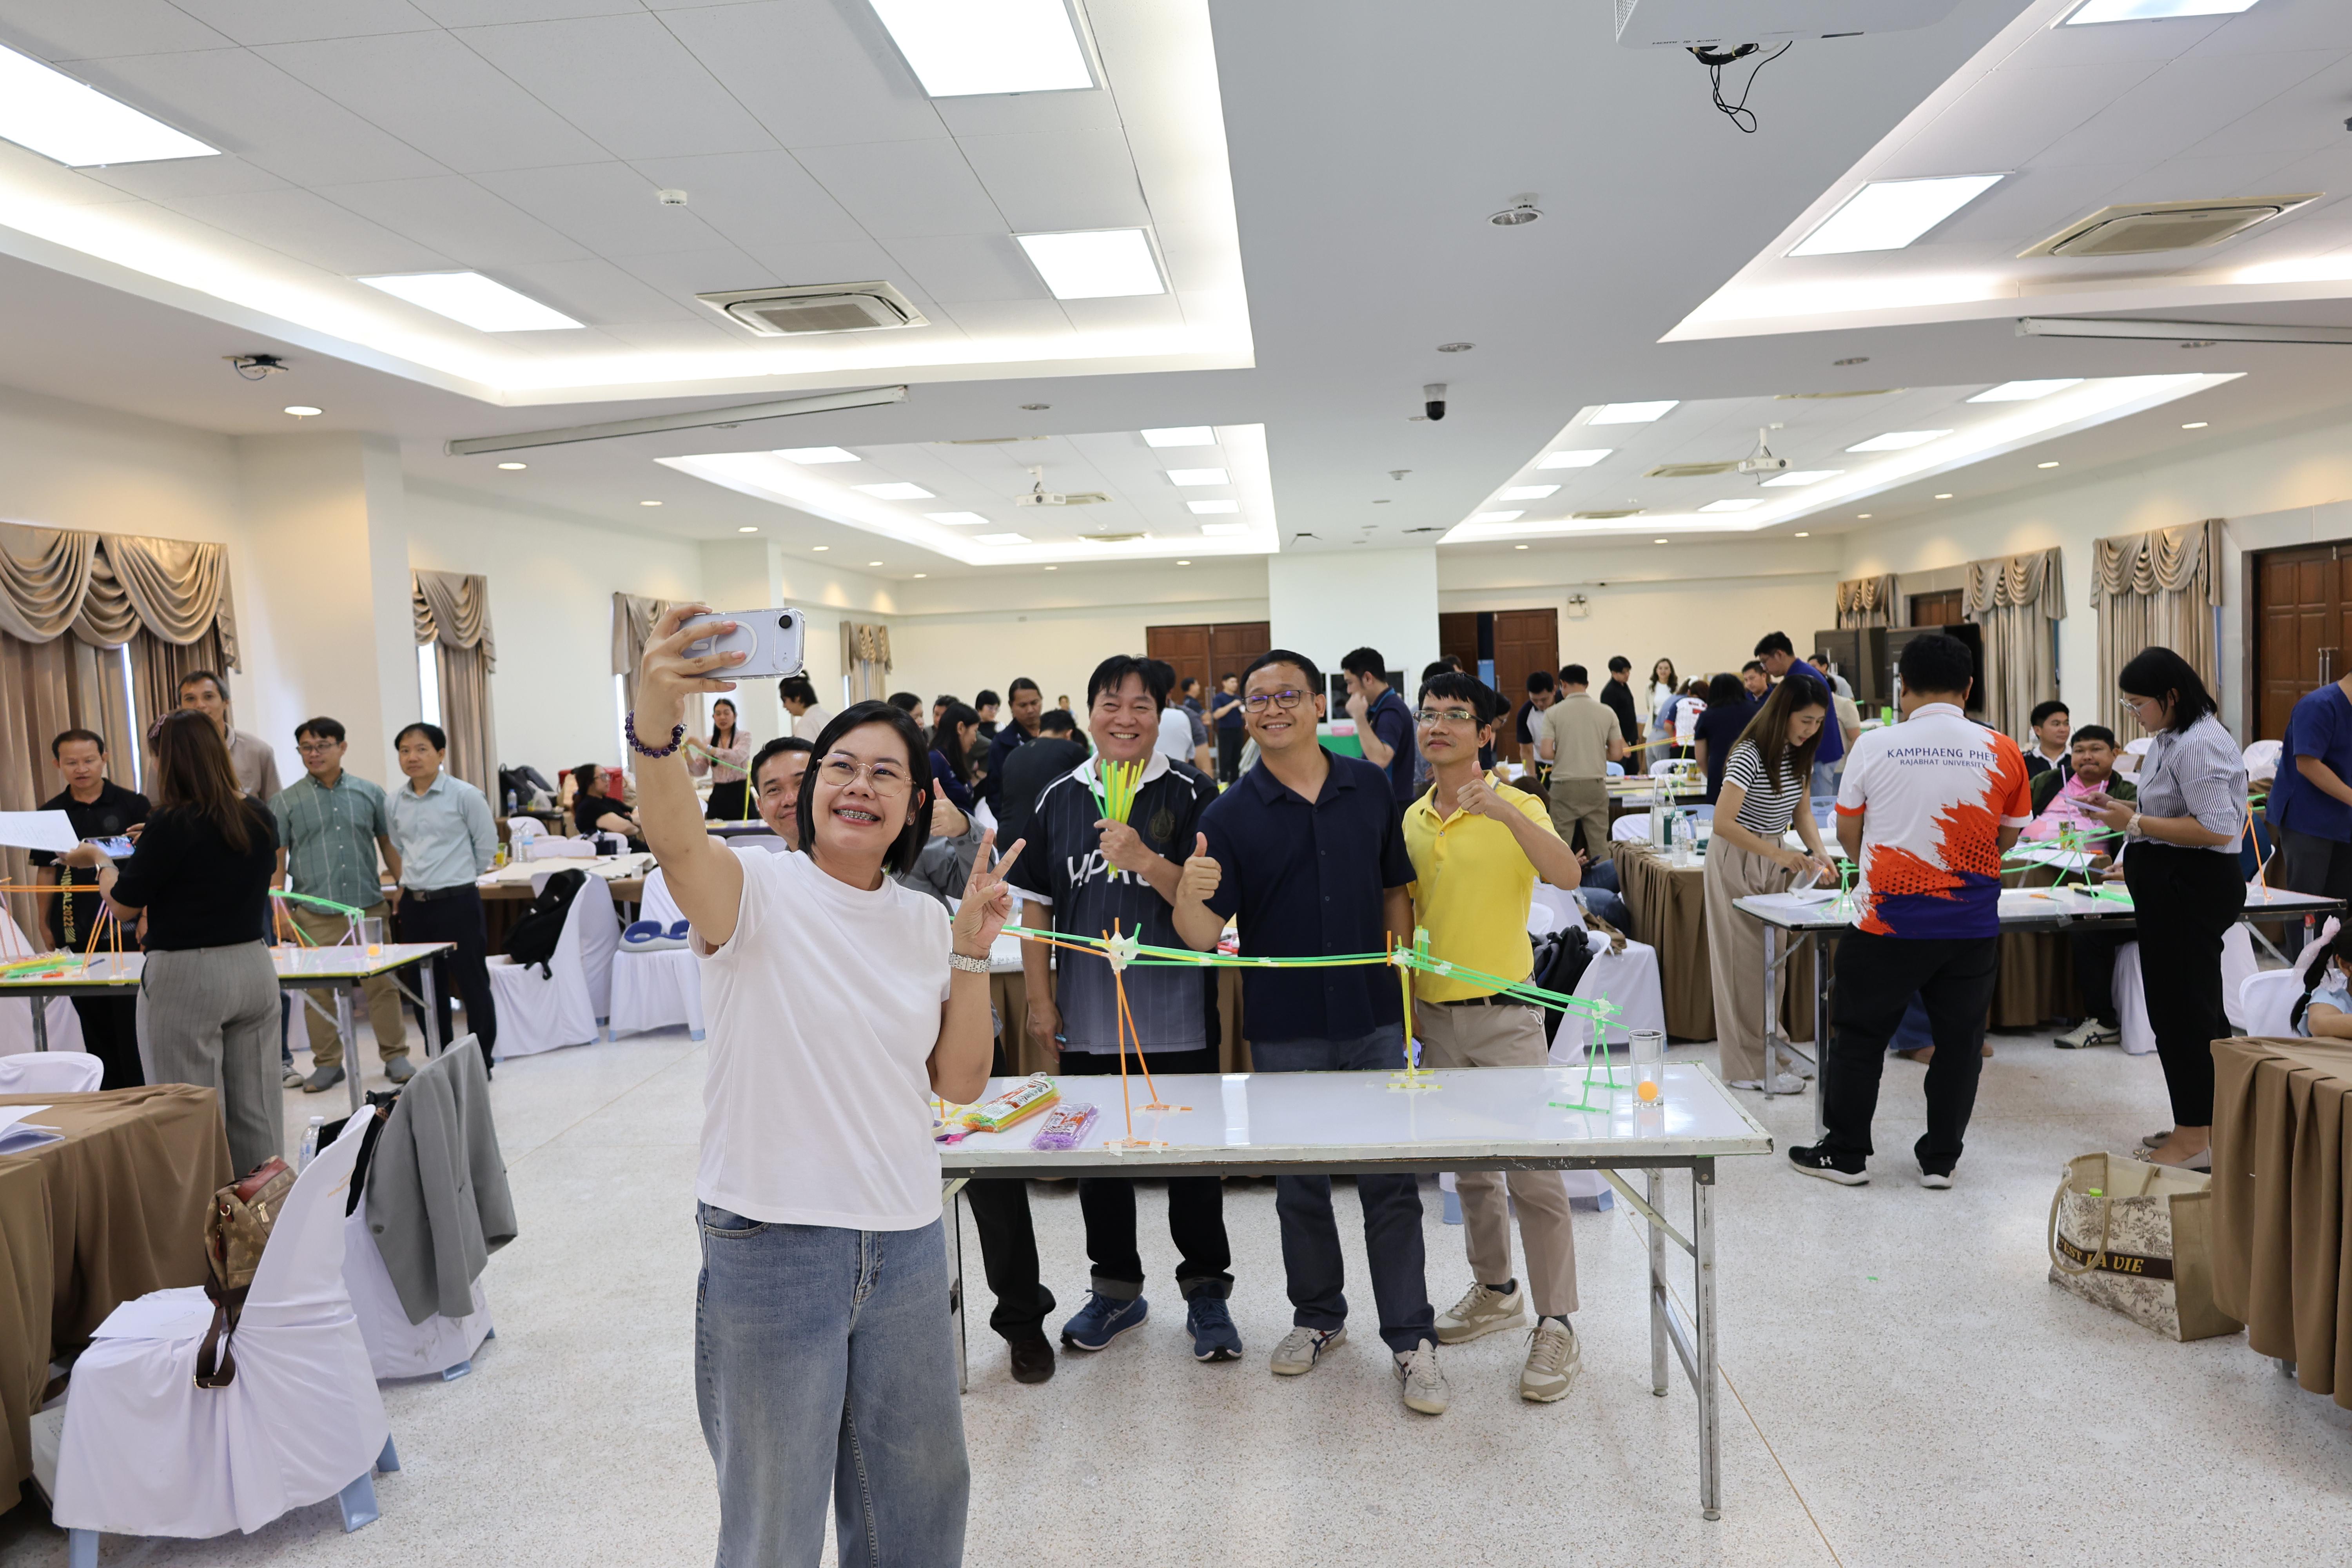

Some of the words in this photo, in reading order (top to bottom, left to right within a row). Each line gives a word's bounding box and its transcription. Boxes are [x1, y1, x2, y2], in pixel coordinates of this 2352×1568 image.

[1887, 748, 1963, 758] KAMPHAENG
[1969, 750, 1996, 762] PHET
[1943, 759, 1986, 768] UNIVERSITY
[2113, 1255, 2144, 1273] VIE
